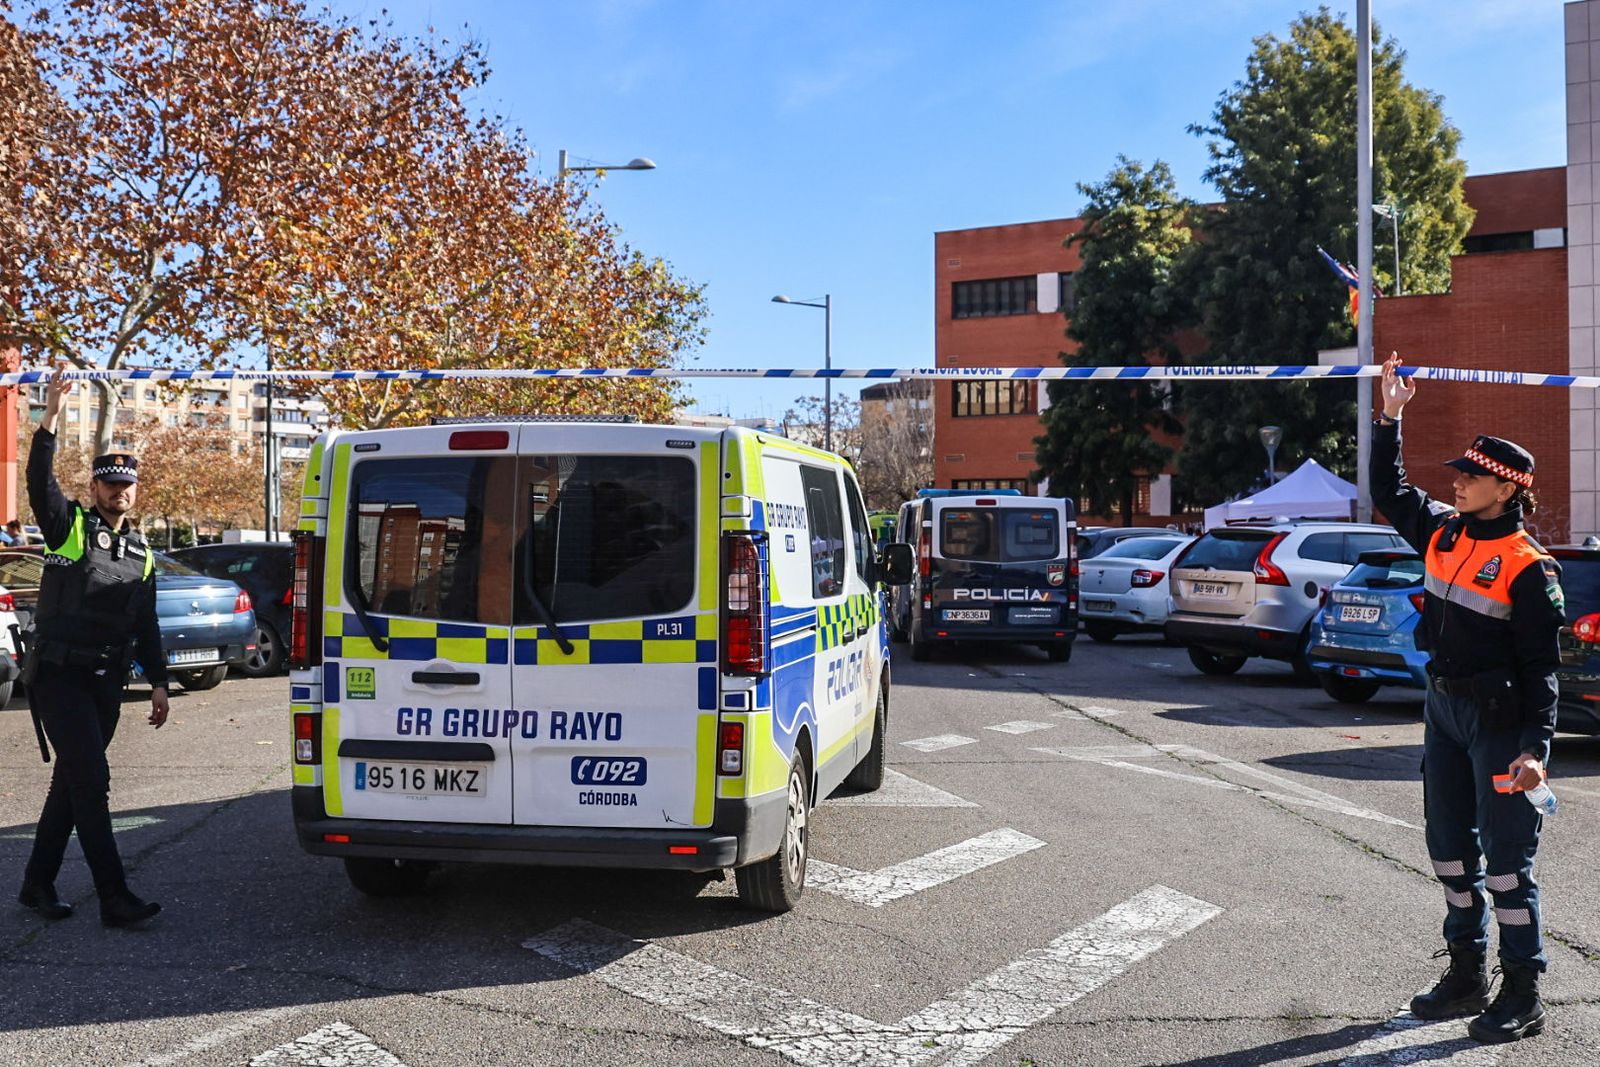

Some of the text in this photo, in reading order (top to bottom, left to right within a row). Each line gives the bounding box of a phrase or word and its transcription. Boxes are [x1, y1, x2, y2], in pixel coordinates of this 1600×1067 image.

[1218, 366, 1260, 375] LOCAL
[657, 622, 683, 636] PL31
[349, 672, 372, 683] 112
[396, 707, 623, 741] GR GRUPO RAYO
[368, 766, 480, 793] 9516 MKZ
[591, 760, 640, 782] 092
[579, 789, 638, 807] CÓRDOBA
